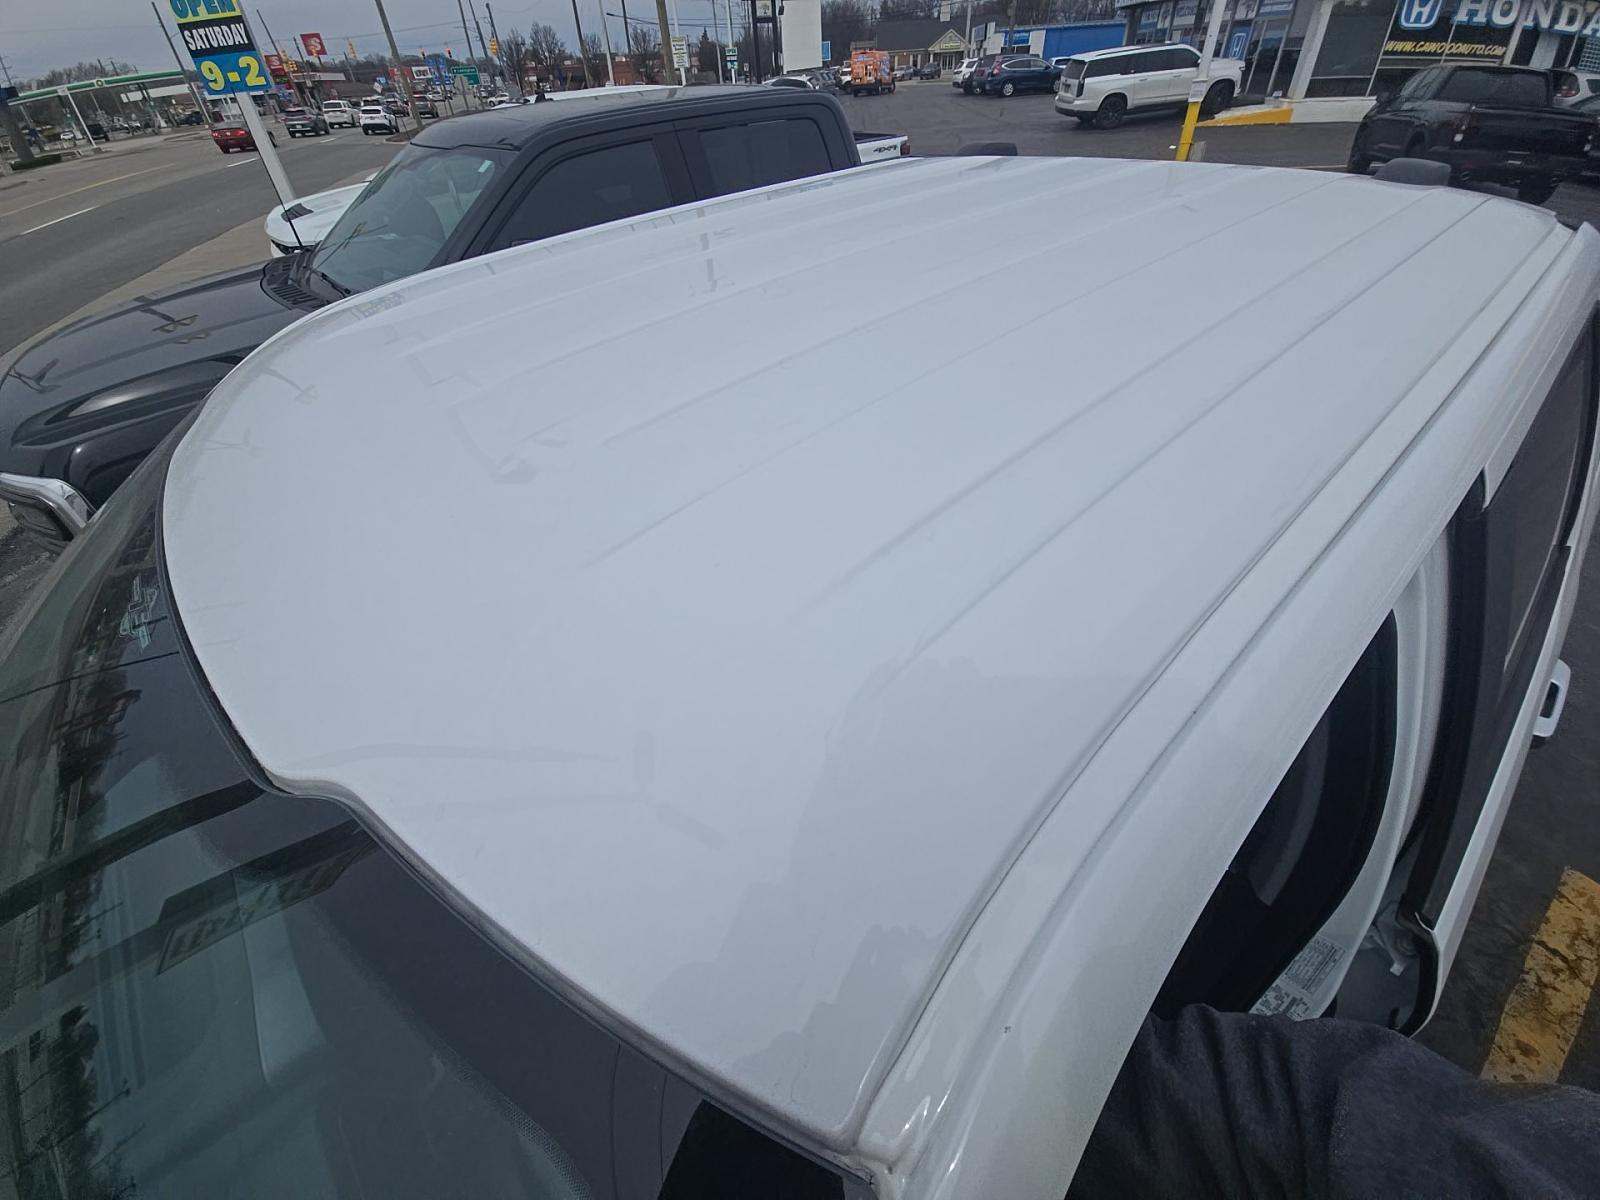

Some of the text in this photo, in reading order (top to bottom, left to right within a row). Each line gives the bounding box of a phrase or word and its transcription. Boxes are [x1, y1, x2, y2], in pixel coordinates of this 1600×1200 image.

[171, 0, 236, 19] OPEN
[184, 23, 248, 51] SATURDAY
[201, 56, 267, 91] 9-2
